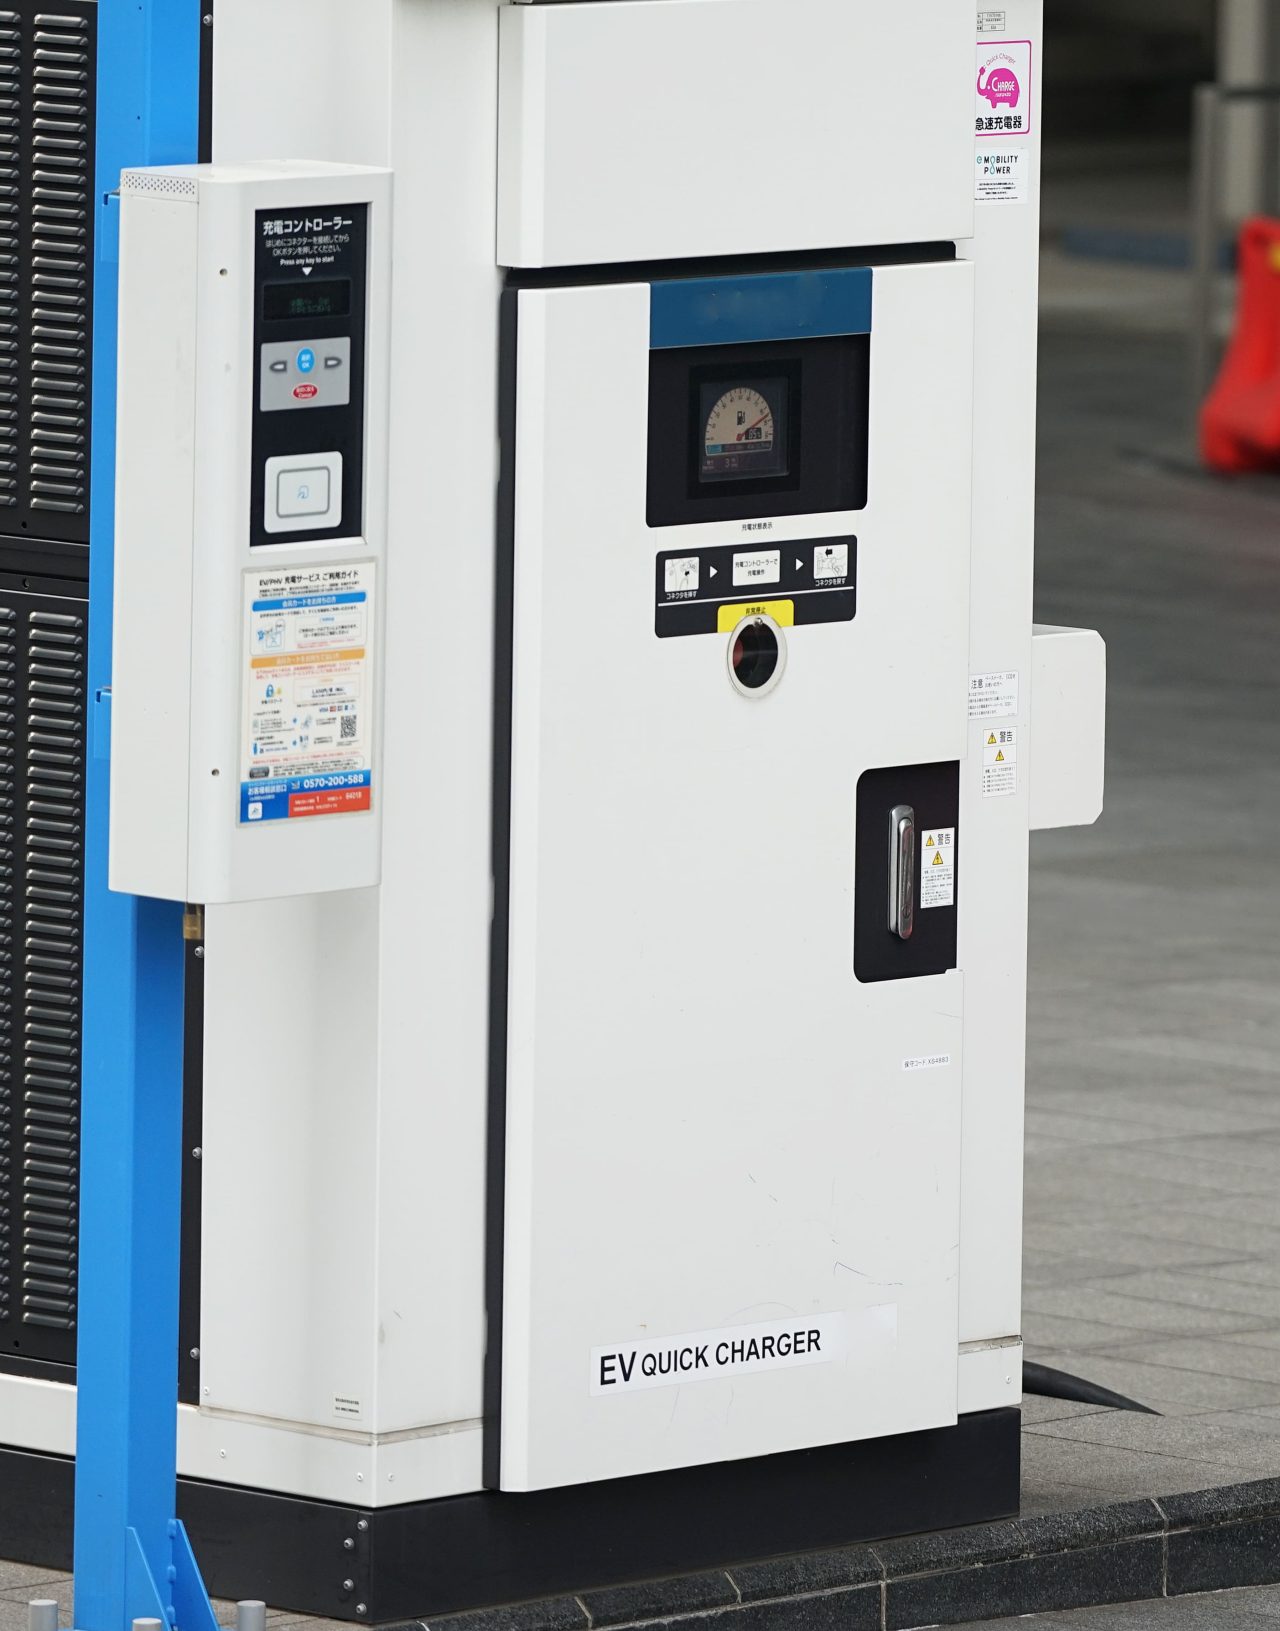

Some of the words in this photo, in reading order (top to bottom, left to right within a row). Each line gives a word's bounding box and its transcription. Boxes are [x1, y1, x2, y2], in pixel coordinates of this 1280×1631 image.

[991, 76, 1015, 92] CHARGE
[975, 115, 1022, 131] 急速充電器
[983, 155, 1019, 164] MOBILITY
[984, 166, 1011, 175] POWER
[263, 216, 352, 235] 充電コントローラー
[280, 258, 295, 266] Press
[306, 257, 315, 265] key
[742, 521, 773, 531] 充電状態表示
[735, 558, 778, 568] 充電コントローラーで
[285, 572, 320, 584] 充電サービス
[322, 570, 359, 581] ご利用ガイド
[745, 606, 766, 615] 非常停止
[971, 678, 984, 689] 注意
[999, 730, 1013, 743] 警告
[303, 773, 364, 789] 0570-200-588
[937, 833, 951, 846] 警告
[600, 1351, 636, 1386] EV
[641, 1345, 709, 1377] QUICK
[715, 1329, 821, 1366] CHARGER
